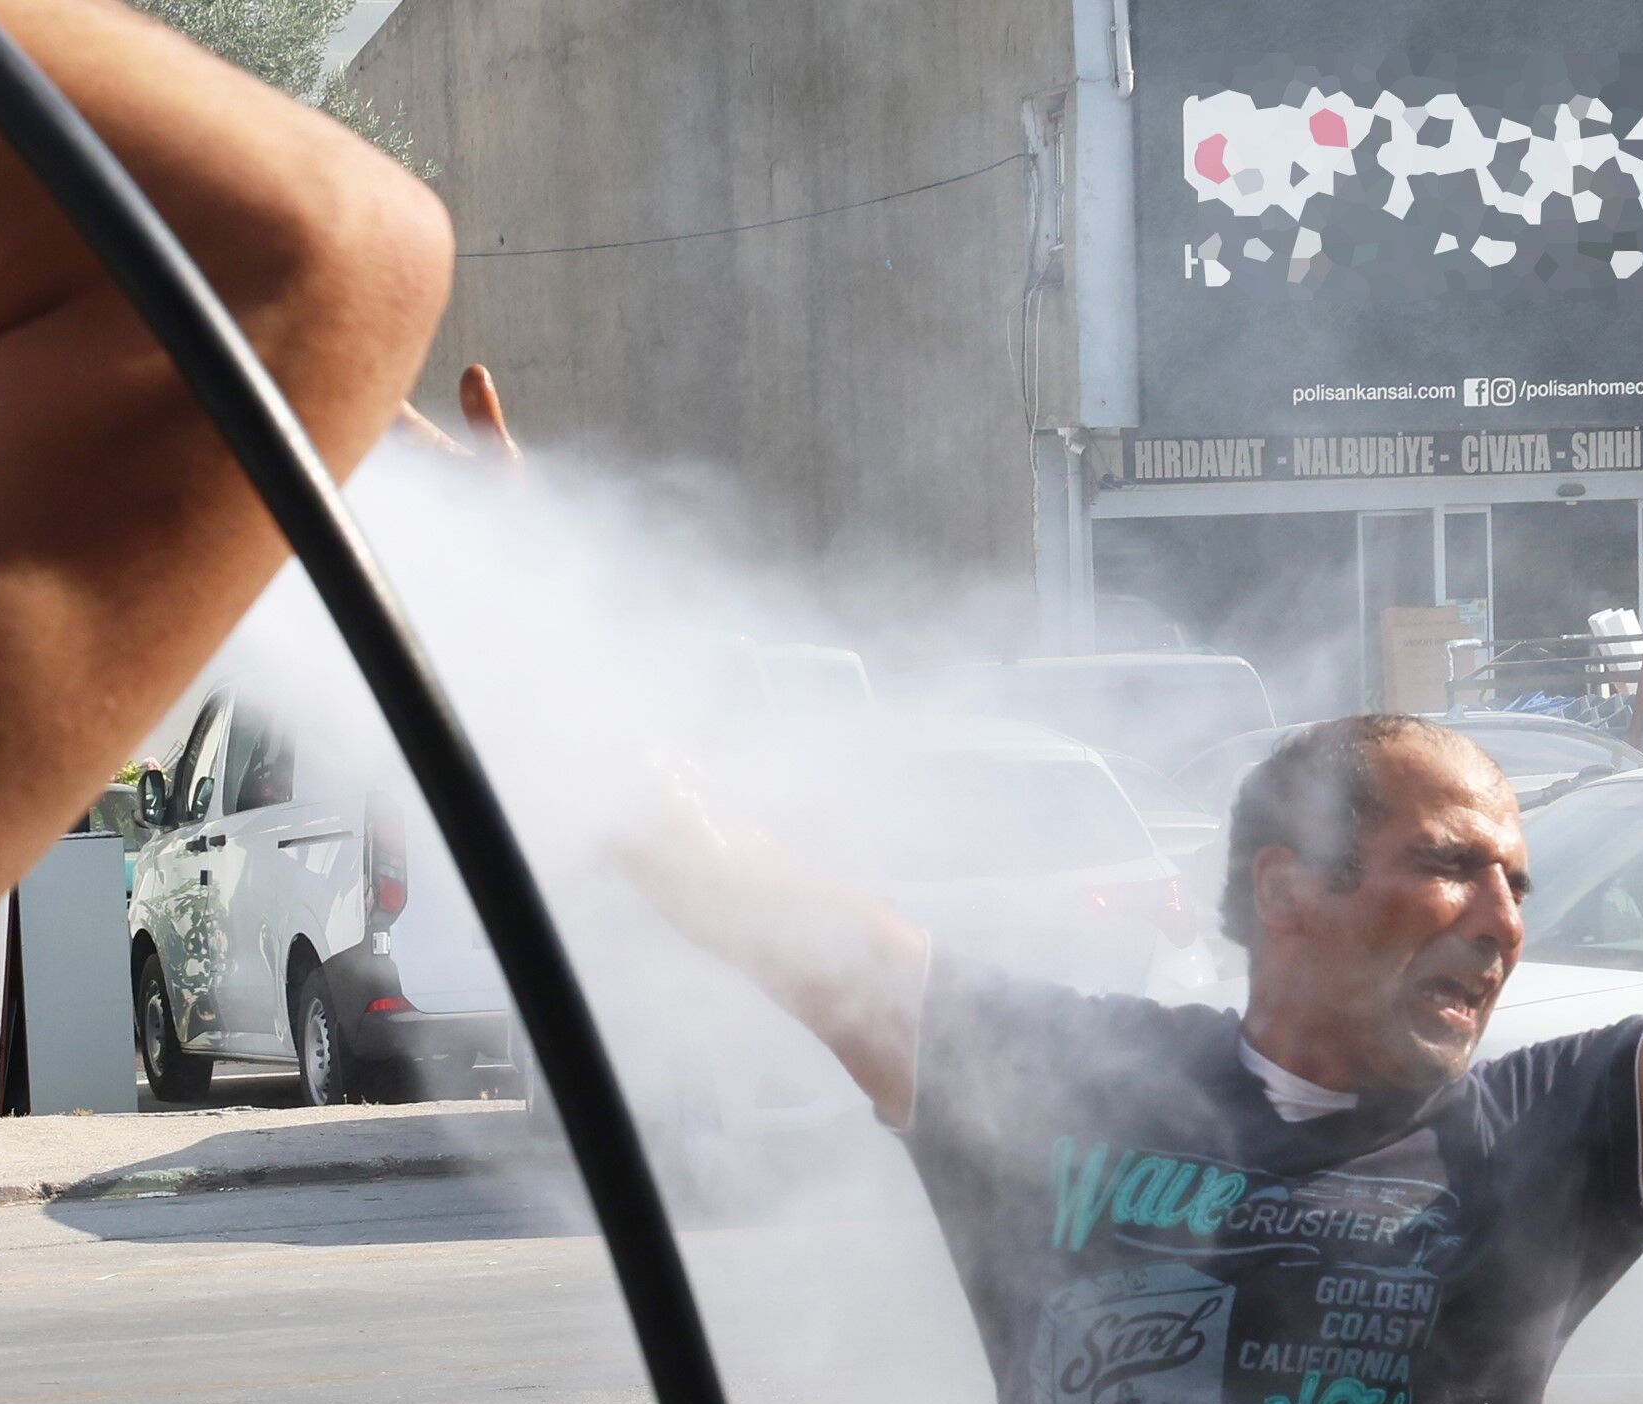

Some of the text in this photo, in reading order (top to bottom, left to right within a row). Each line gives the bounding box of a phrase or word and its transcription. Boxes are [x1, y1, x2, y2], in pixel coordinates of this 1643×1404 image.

[1293, 382, 1456, 405] polisankansai.com
[1134, 437, 1266, 479] HIRDAVAT
[1293, 431, 1435, 476] NALBURİYE
[1460, 429, 1552, 474] CİVATA
[1571, 426, 1642, 470] SIHHİ
[1224, 1202, 1402, 1245] CRUSHER
[1315, 1275, 1435, 1313] GOLDEN
[1319, 1311, 1426, 1349] COAST
[1238, 1340, 1412, 1383] CALIFORNIA
